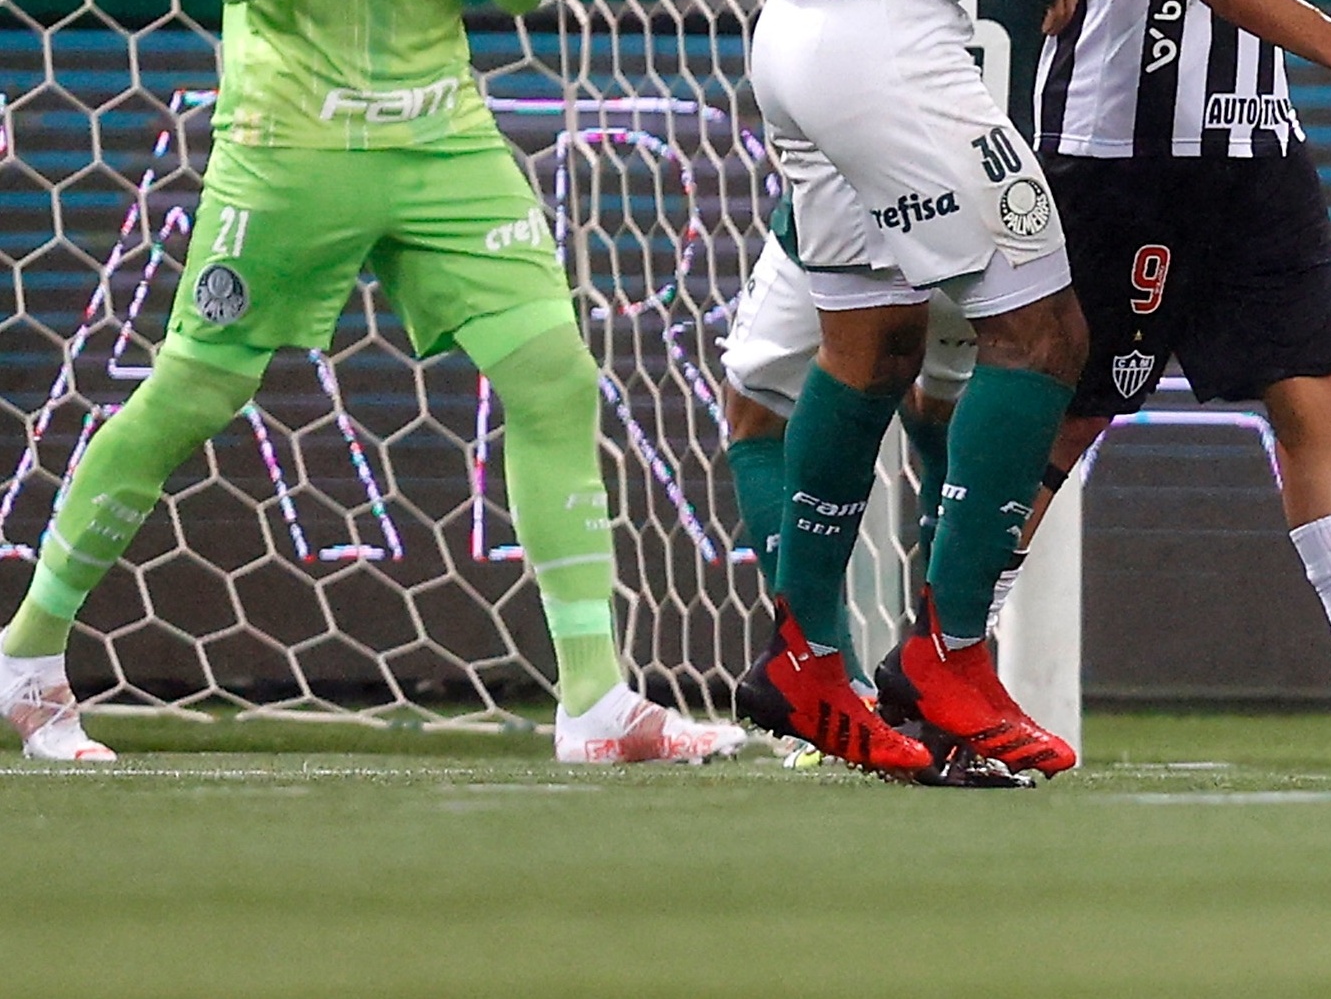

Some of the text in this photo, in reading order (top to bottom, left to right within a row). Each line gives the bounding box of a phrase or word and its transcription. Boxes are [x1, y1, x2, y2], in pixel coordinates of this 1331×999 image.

[320, 78, 459, 122] Fam
[971, 127, 1022, 183] 30
[211, 205, 250, 257] 21
[869, 190, 960, 233] refisa
[1130, 244, 1171, 314] 9
